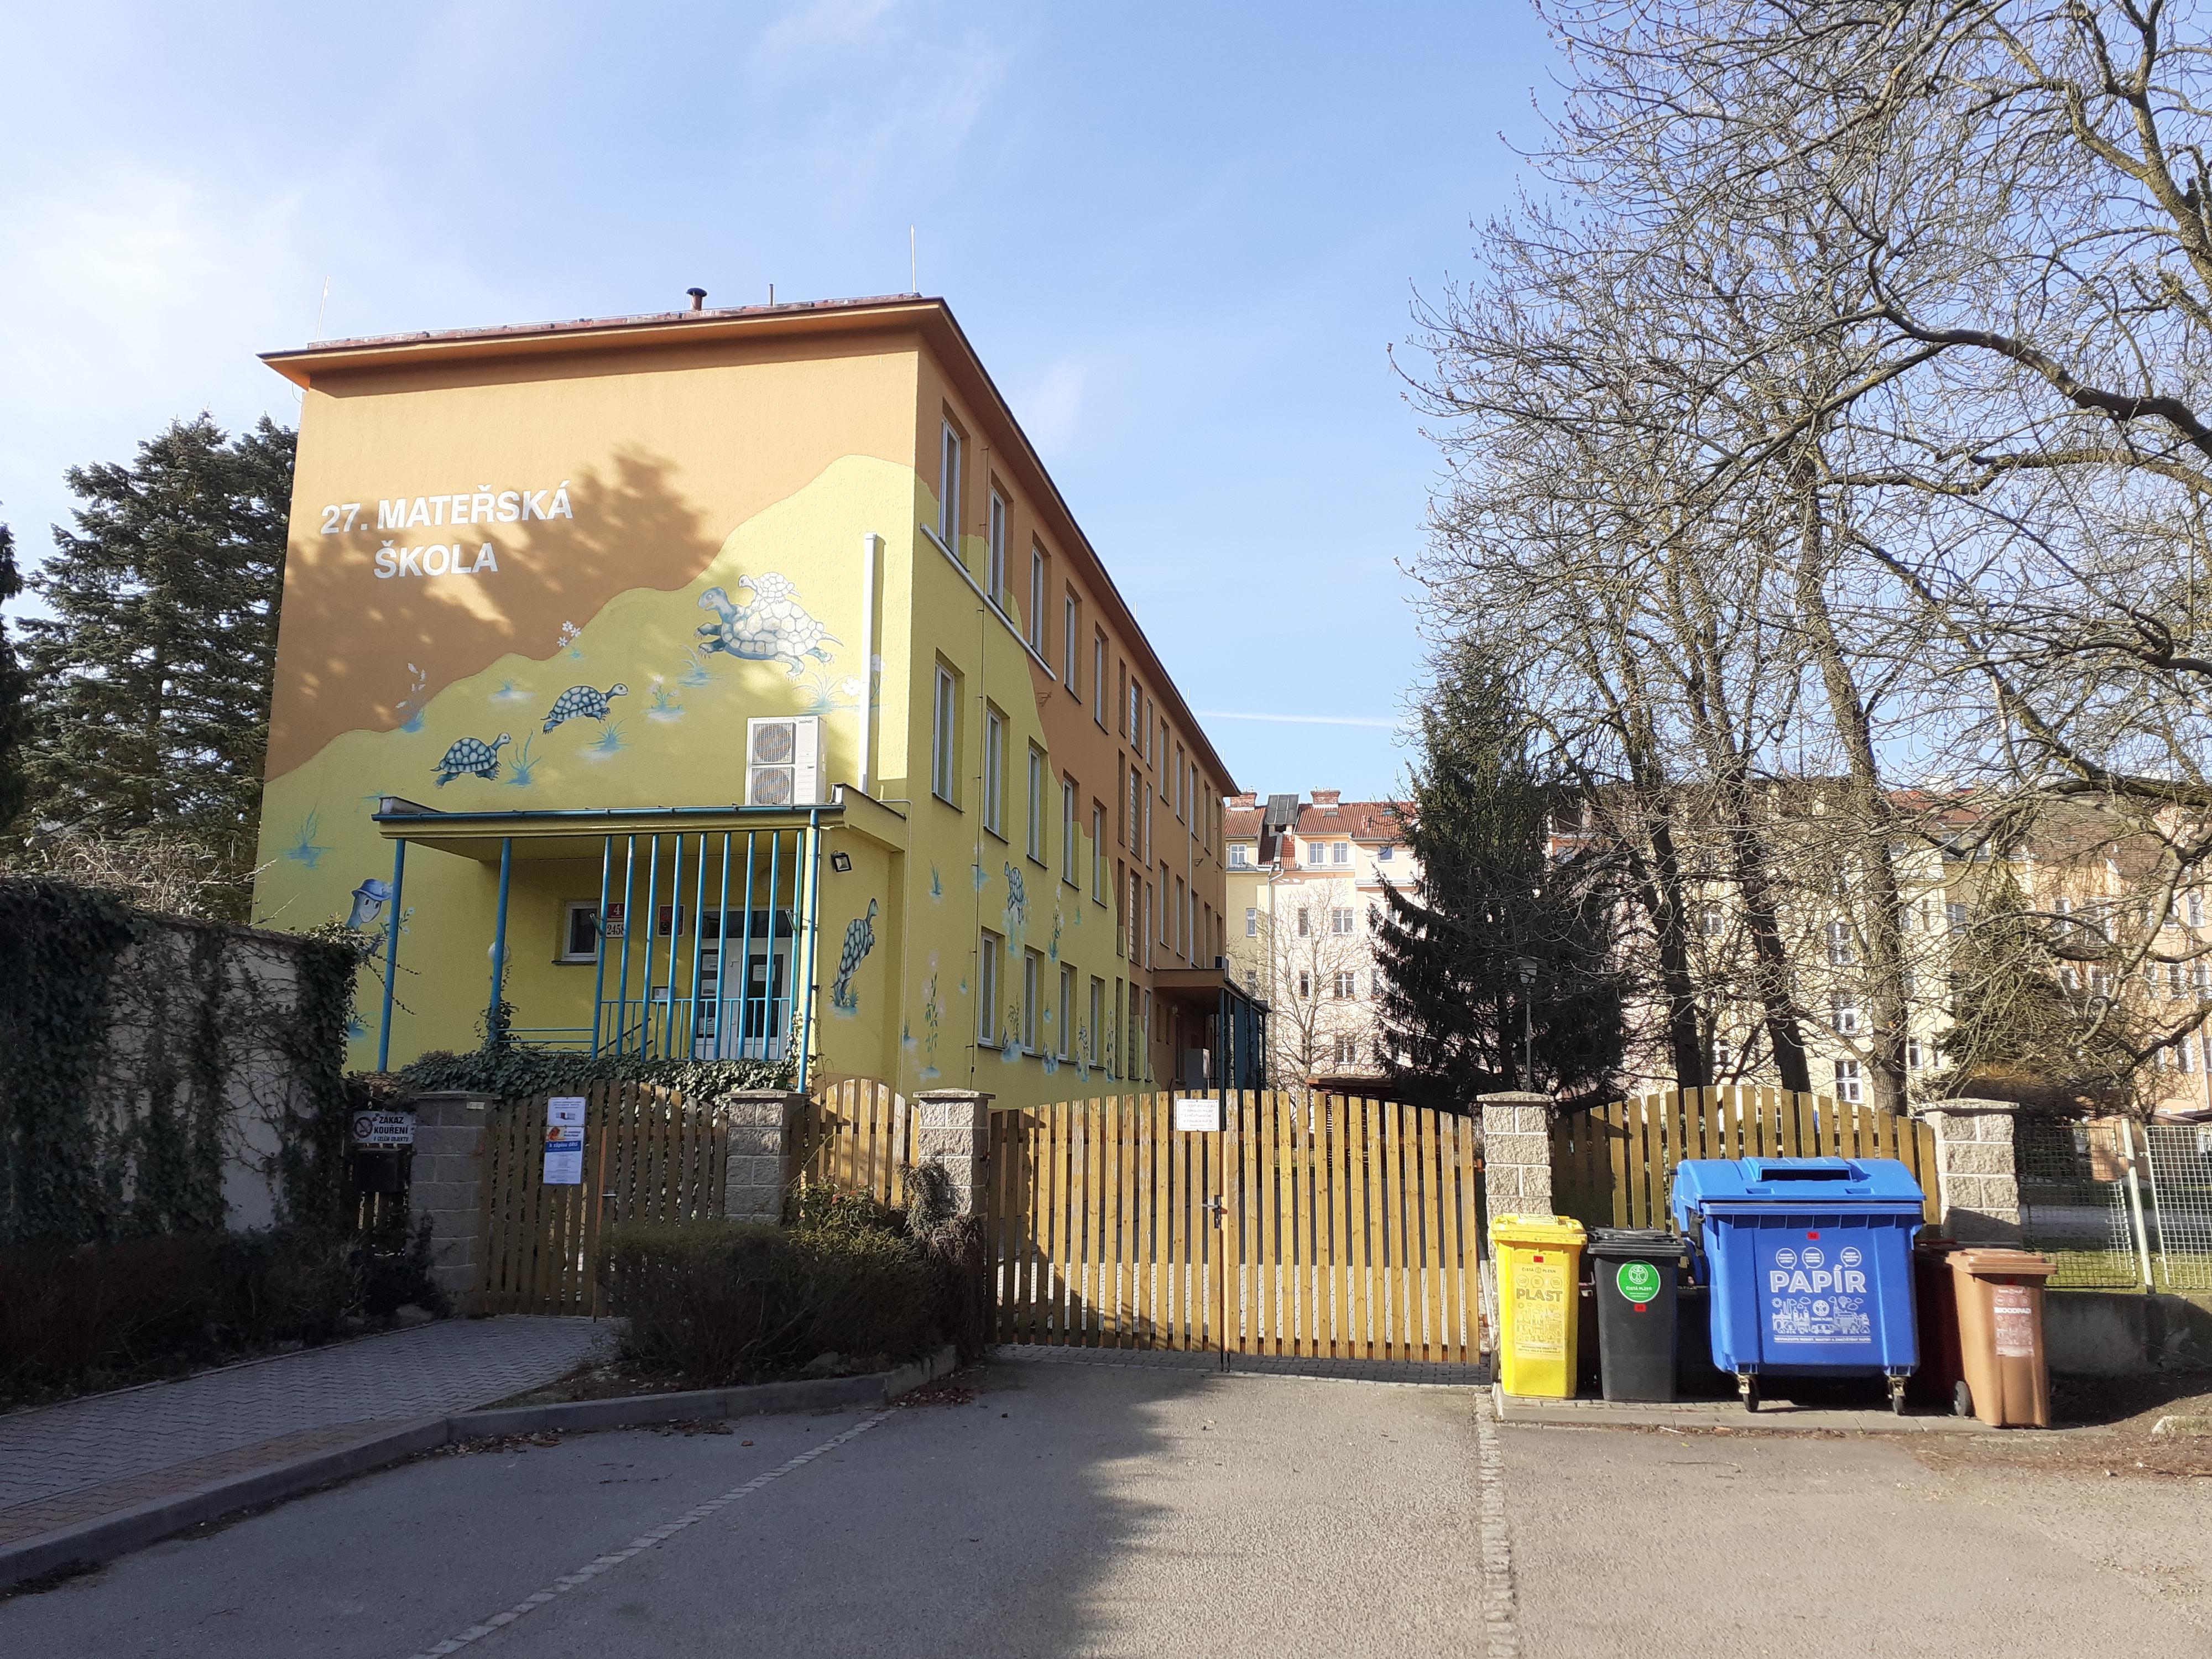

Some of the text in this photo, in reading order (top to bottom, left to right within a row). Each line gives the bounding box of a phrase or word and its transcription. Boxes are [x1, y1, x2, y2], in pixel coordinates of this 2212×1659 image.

[321, 480, 573, 535] 27. MATEŘSKÁ
[373, 540, 498, 579] ŠKOLA
[614, 904, 620, 915] 4
[374, 1125, 409, 1134] KOUŘENÍ
[1770, 1264, 1867, 1293] PAPÍR
[1516, 1287, 1563, 1302] PLAST
